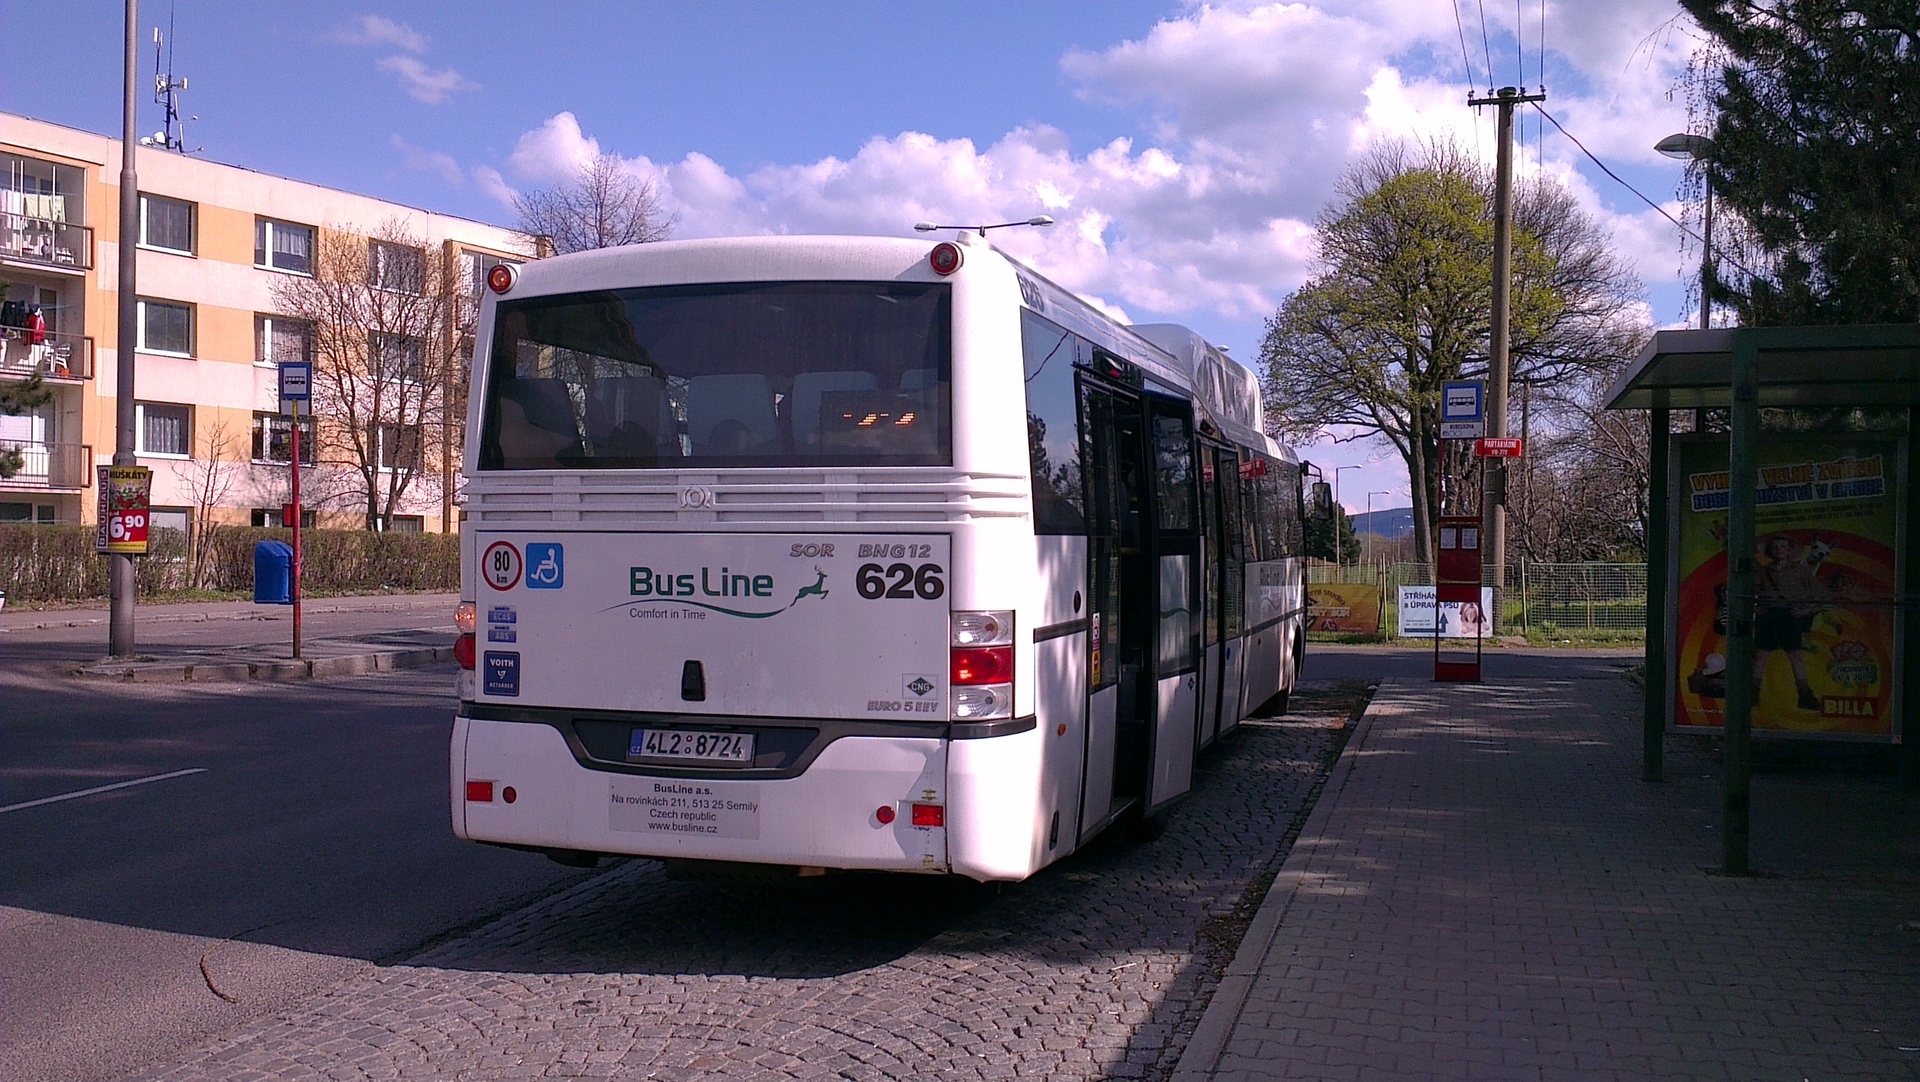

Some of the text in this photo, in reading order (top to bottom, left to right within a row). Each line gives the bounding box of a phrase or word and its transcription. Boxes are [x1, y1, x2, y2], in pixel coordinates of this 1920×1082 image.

[99, 470, 108, 546] BAUHAUS
[790, 543, 835, 559] SOR
[494, 550, 510, 571] 80
[496, 573, 508, 583] km
[856, 563, 944, 600] 626
[1404, 592, 1436, 600] STŘÍHÁN
[493, 612, 511, 621] ECAS
[629, 608, 706, 620] Comfort in Time
[495, 632, 509, 640] ABS
[489, 658, 514, 667] VOITH
[911, 682, 930, 691] CNG
[867, 700, 939, 712] EURO 5 EEV
[1824, 699, 1874, 716] BILLA
[646, 733, 743, 759] 4L2 8724
[654, 784, 713, 795] BusLine a.s.
[612, 795, 758, 813] Na rovinkách 211, 513 25 Semily
[650, 809, 717, 822] Czech republic
[648, 821, 718, 833] www.busline.cz
